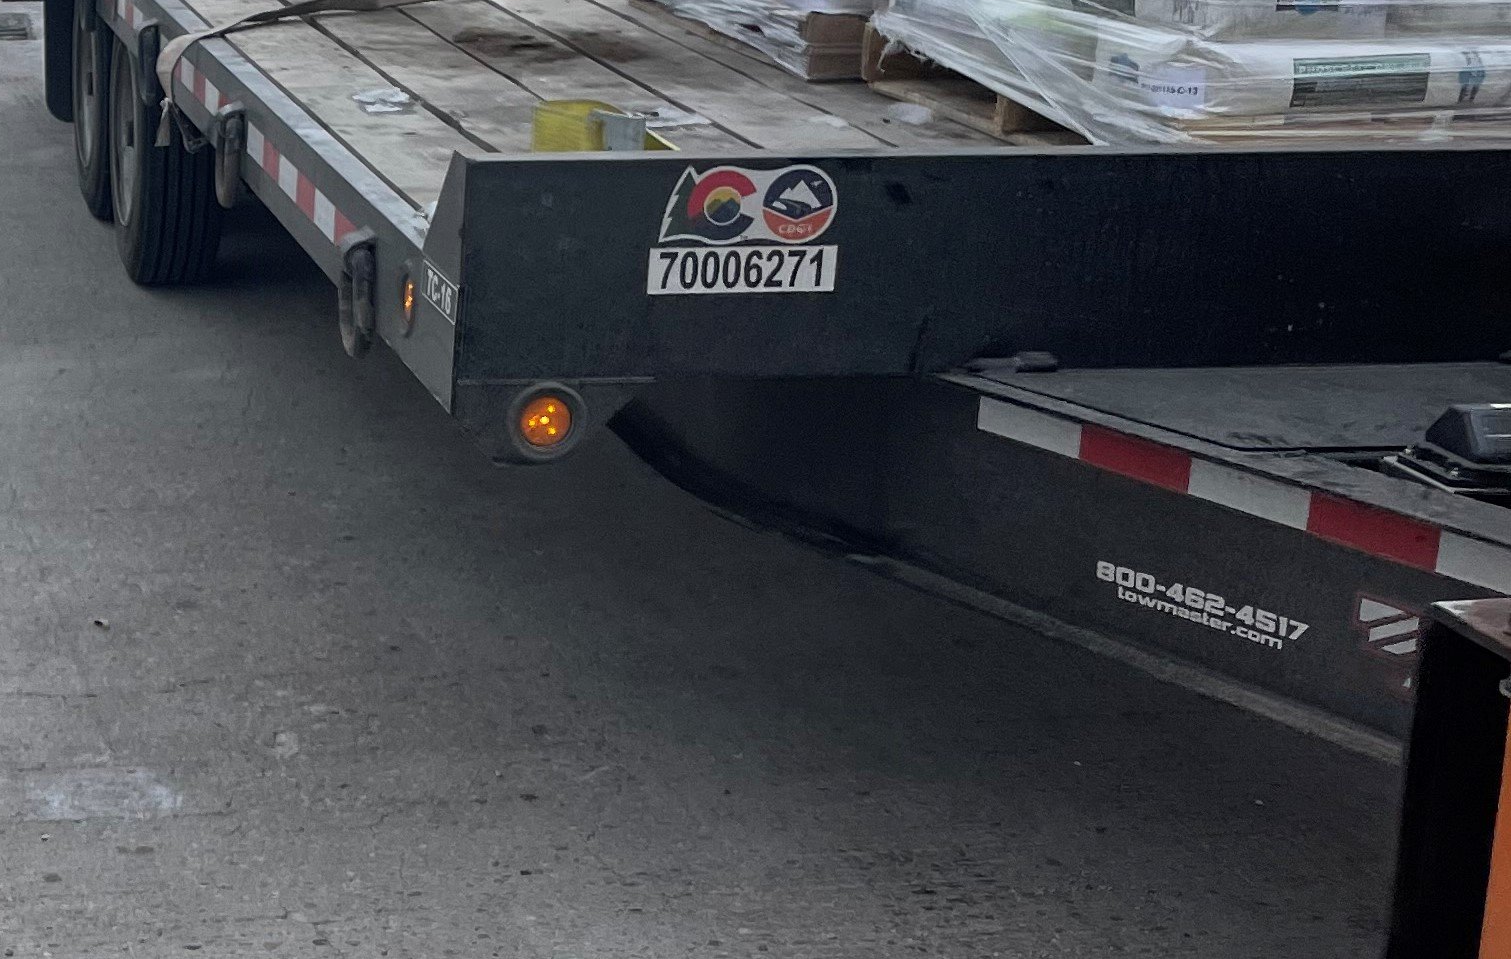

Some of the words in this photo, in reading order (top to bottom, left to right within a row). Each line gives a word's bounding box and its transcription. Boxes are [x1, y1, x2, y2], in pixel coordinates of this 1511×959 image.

[427, 268, 452, 315] TC-16
[659, 248, 824, 290] 70006271
[1096, 560, 1310, 640] 800-462-4517
[1117, 586, 1283, 649] towmaster.com
